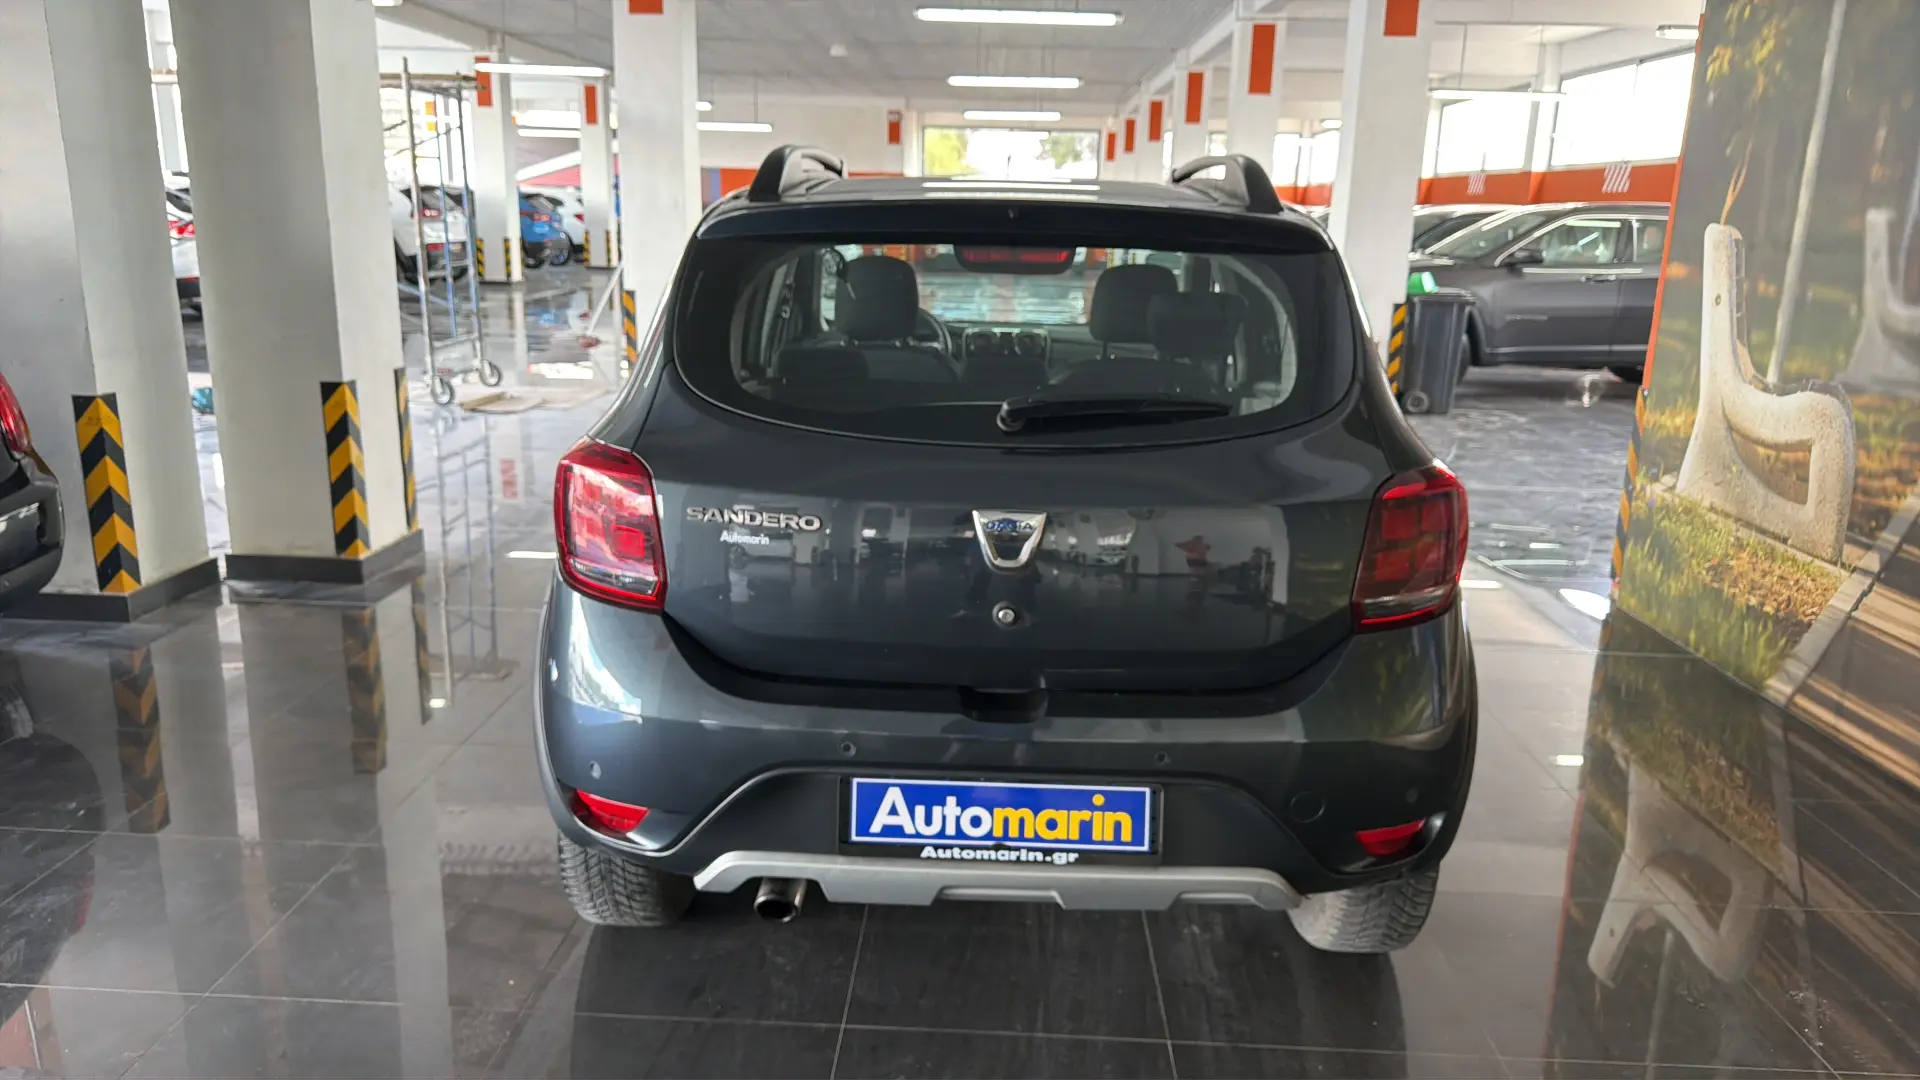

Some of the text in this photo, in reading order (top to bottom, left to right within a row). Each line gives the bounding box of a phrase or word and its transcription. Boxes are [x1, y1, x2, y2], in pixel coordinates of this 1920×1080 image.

[686, 506, 821, 531] SANDERO
[986, 520, 1034, 532] DACIA
[720, 530, 769, 545] Automarin
[869, 786, 1132, 842] Automarin
[920, 845, 1079, 865] Automarin.gr
